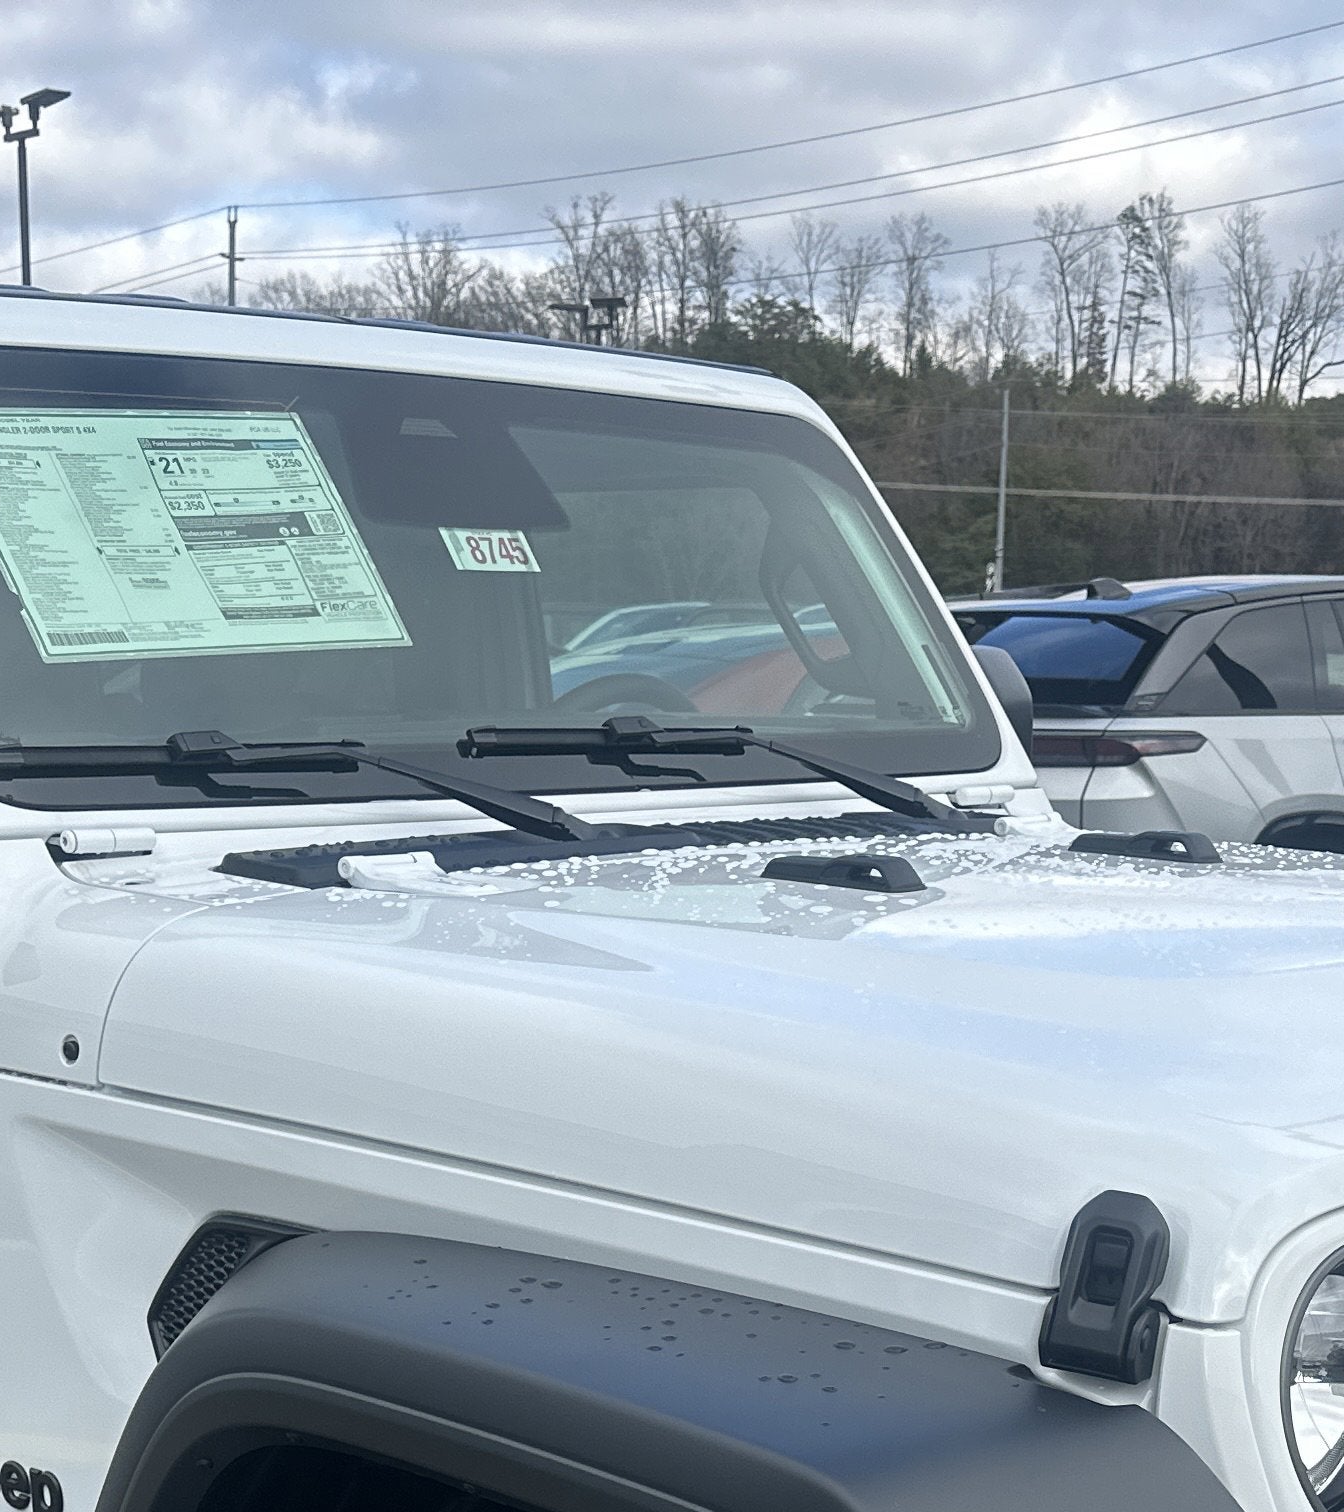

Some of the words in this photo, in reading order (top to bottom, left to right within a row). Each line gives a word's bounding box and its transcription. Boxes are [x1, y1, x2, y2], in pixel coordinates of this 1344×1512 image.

[22, 426, 51, 435] 2-DOOR
[51, 426, 74, 434] SPORT
[158, 457, 185, 474] 21
[266, 459, 303, 469] $3,250
[168, 501, 205, 511] $2,350
[466, 536, 529, 565] 8745
[320, 600, 377, 612] FlexCare
